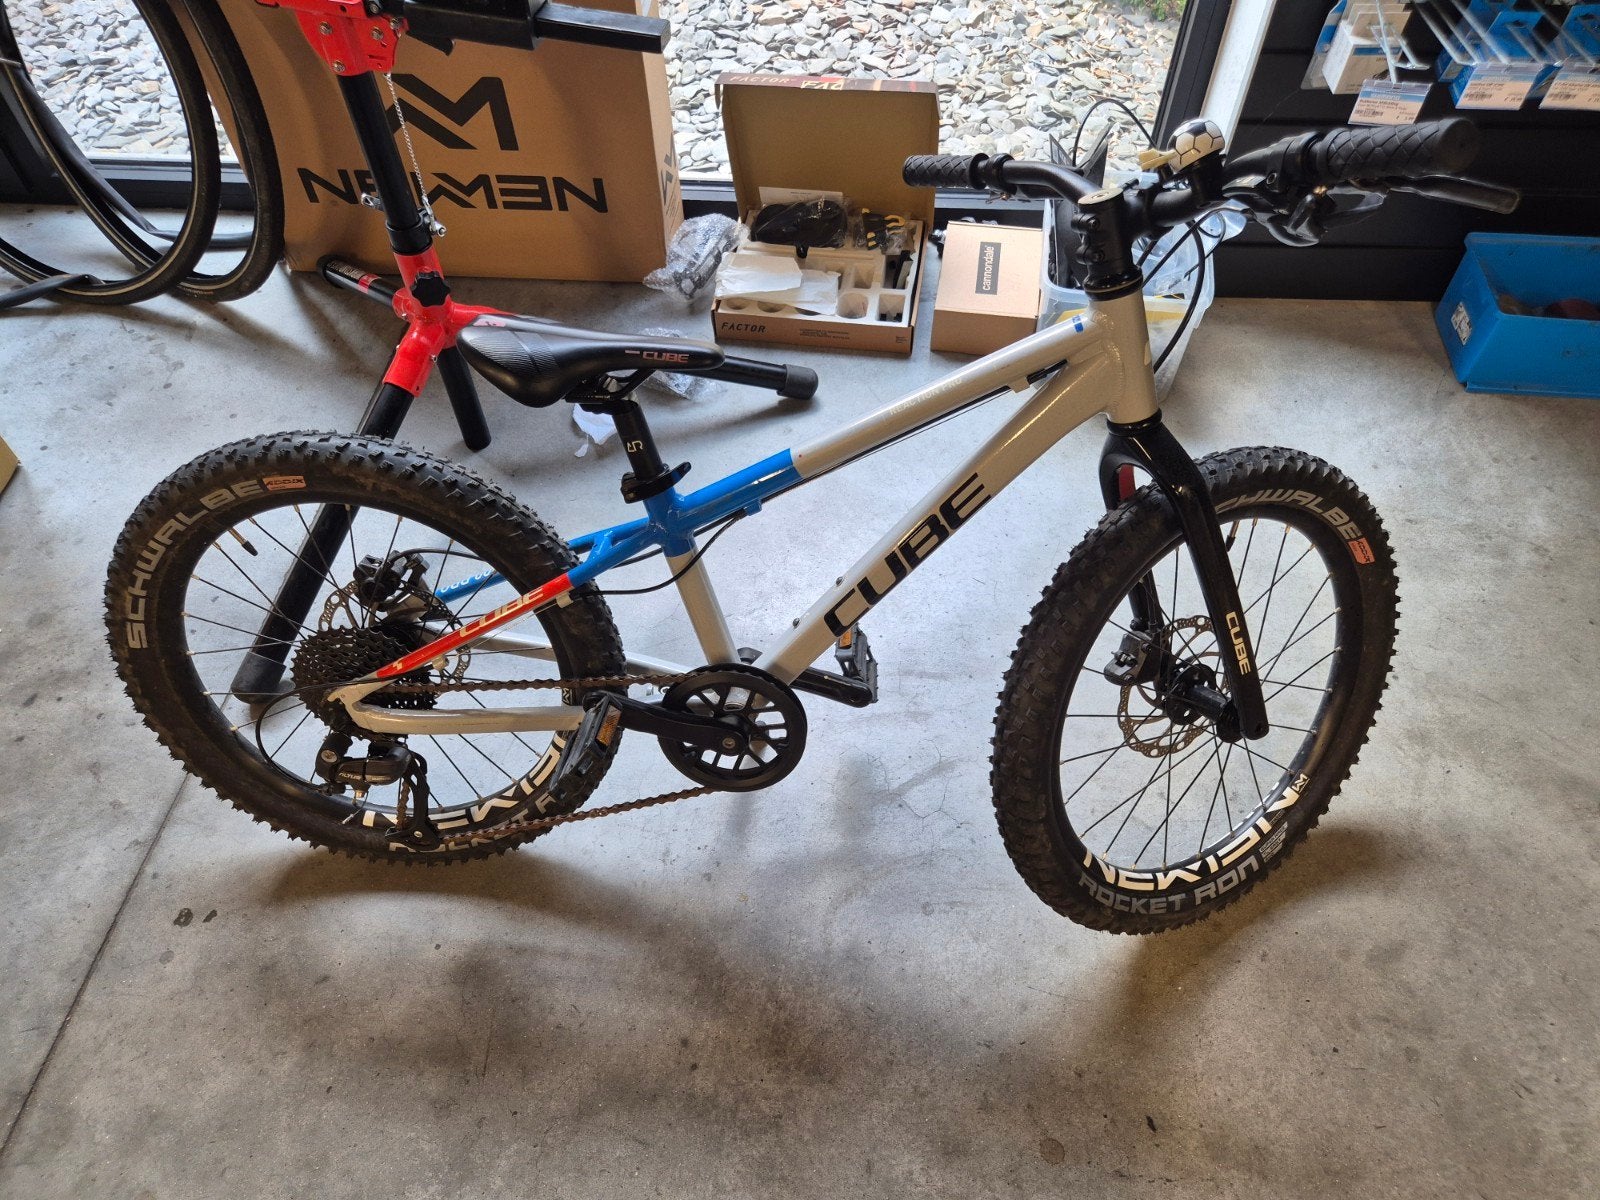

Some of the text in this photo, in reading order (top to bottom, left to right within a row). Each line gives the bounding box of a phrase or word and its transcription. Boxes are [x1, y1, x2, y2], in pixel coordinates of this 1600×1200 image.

[982, 245, 995, 291] cannondale
[642, 350, 690, 364] CUBE
[721, 321, 767, 333] FACTOR
[1215, 488, 1364, 540] CHWALBE
[126, 479, 264, 649] SCHWALBE
[824, 471, 992, 638] CUBE
[1225, 611, 1252, 676] CUBE
[1082, 786, 1301, 892] NEWMEN
[1078, 853, 1261, 916] ROCKET RON
